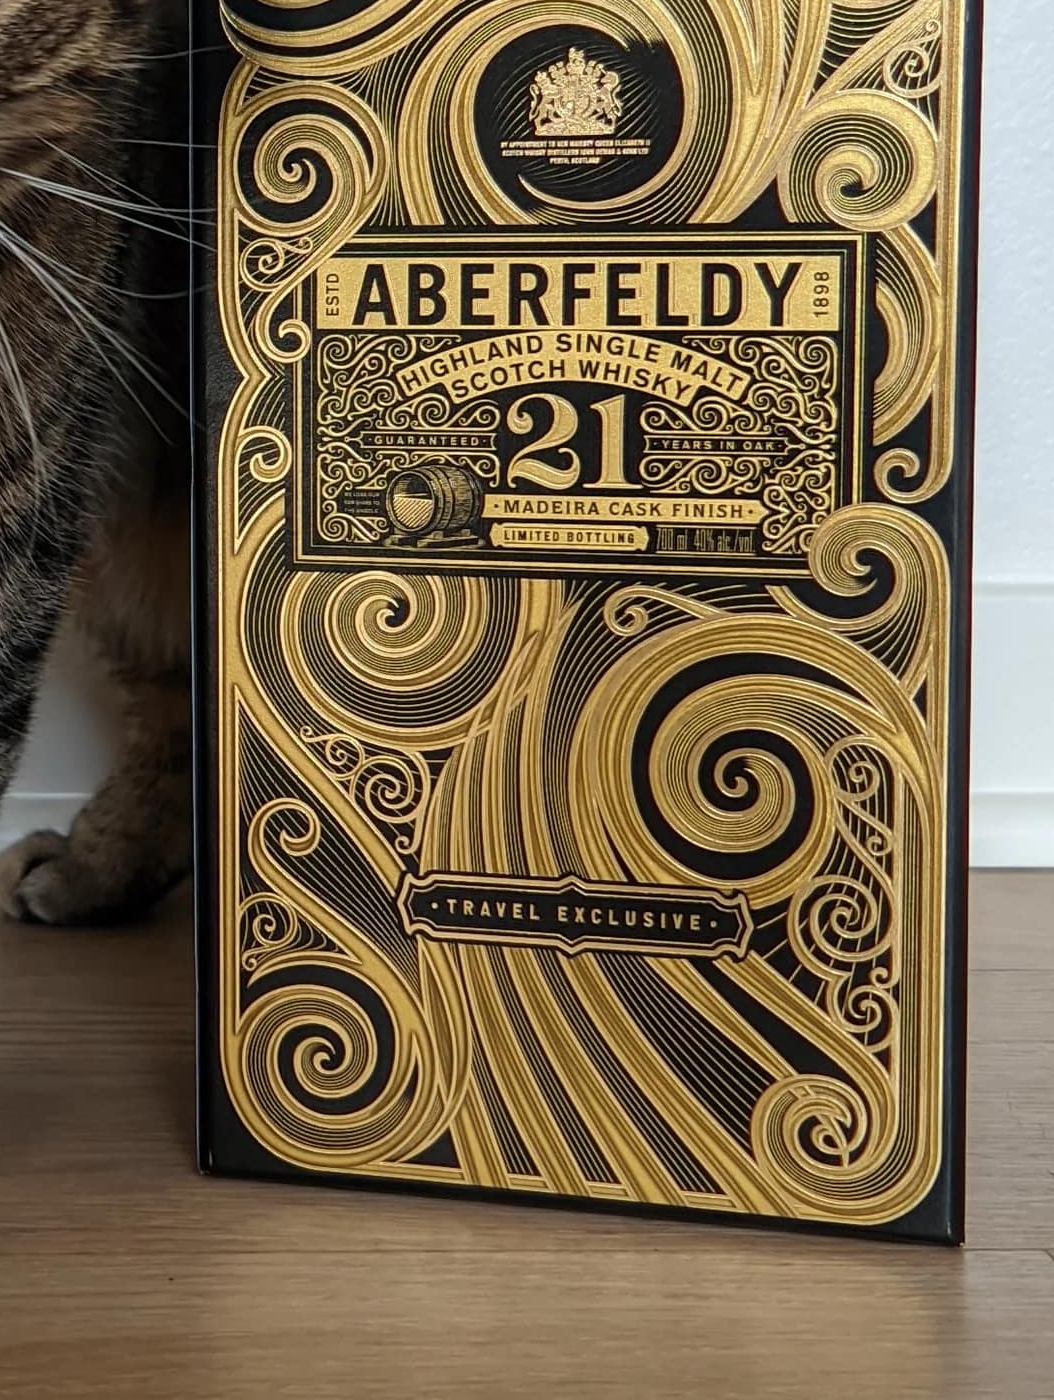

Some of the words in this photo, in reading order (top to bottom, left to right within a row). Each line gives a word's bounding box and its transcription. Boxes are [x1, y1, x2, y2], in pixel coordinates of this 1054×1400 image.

[325, 272, 340, 317] ESTD
[352, 262, 803, 327] ABERFELDY
[813, 271, 830, 318] 1898
[401, 335, 543, 392] HIGHLAND
[556, 333, 661, 363] SINGLE
[670, 351, 743, 393] MALT
[452, 359, 566, 399] SCOTCH
[579, 359, 692, 401] WHISKY
[374, 434, 481, 447] GUARANTEED
[507, 393, 643, 490] 21
[661, 439, 713, 450] YEARS
[720, 440, 735, 450] IN
[742, 441, 775, 451] OAK
[503, 499, 601, 515] MADEIRA
[609, 501, 662, 517] CASK
[672, 503, 744, 518] FINISH
[503, 529, 560, 542] LIMITED
[566, 530, 635, 544] BOTTLING
[447, 898, 540, 921] TRAVEL
[558, 906, 702, 931] EXCLUSIVE
